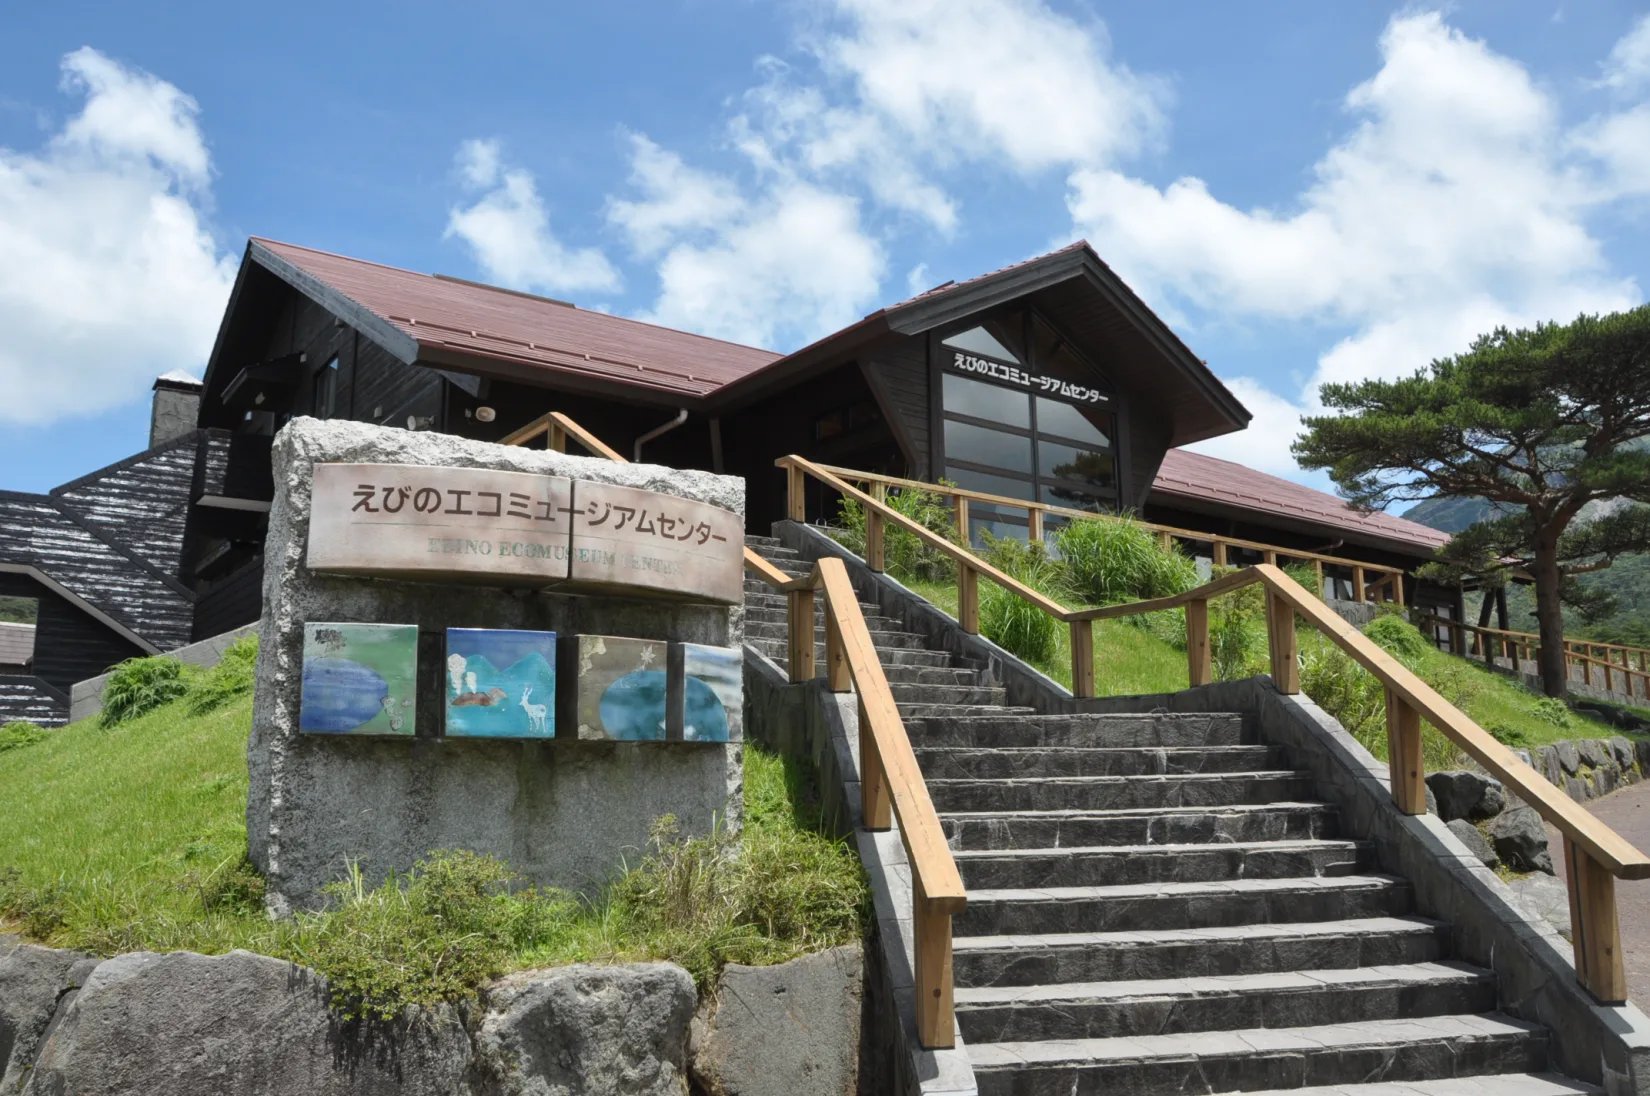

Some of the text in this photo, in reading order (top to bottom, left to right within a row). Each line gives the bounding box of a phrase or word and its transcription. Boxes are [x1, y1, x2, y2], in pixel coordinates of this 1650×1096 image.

[954, 353, 1109, 402] えびのエコミュージアムセンター
[351, 484, 727, 545] えびのエコミュージアムセンター
